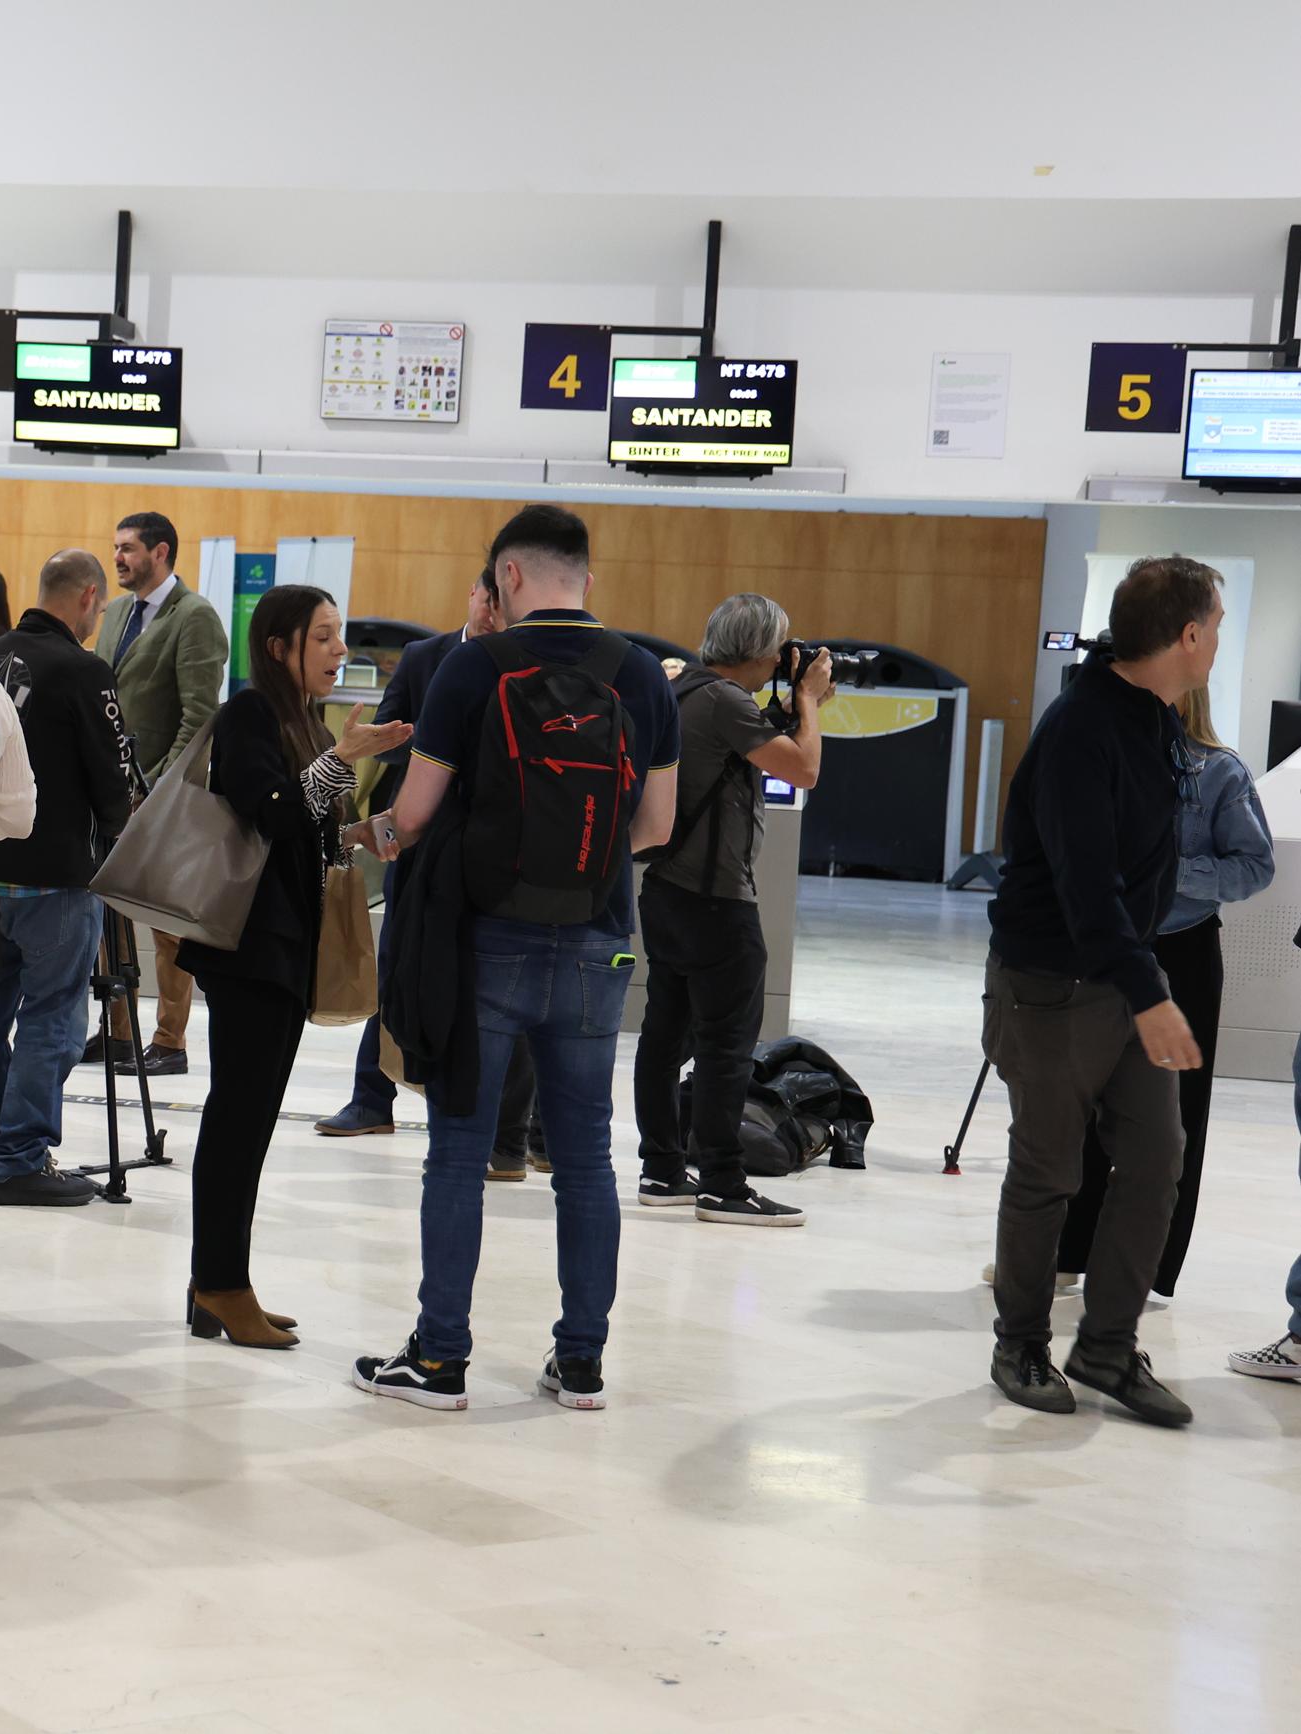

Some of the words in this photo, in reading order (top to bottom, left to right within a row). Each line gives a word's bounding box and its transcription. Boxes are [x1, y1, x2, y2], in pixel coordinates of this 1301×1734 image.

[112, 349, 134, 364] NT
[548, 354, 582, 398] 4
[720, 363, 744, 378] NT
[33, 388, 161, 412] SANTANDER
[1117, 374, 1152, 421] 5
[631, 407, 773, 428] SANTANDER
[628, 446, 681, 457] BINTER
[577, 794, 596, 873] alpinestars
